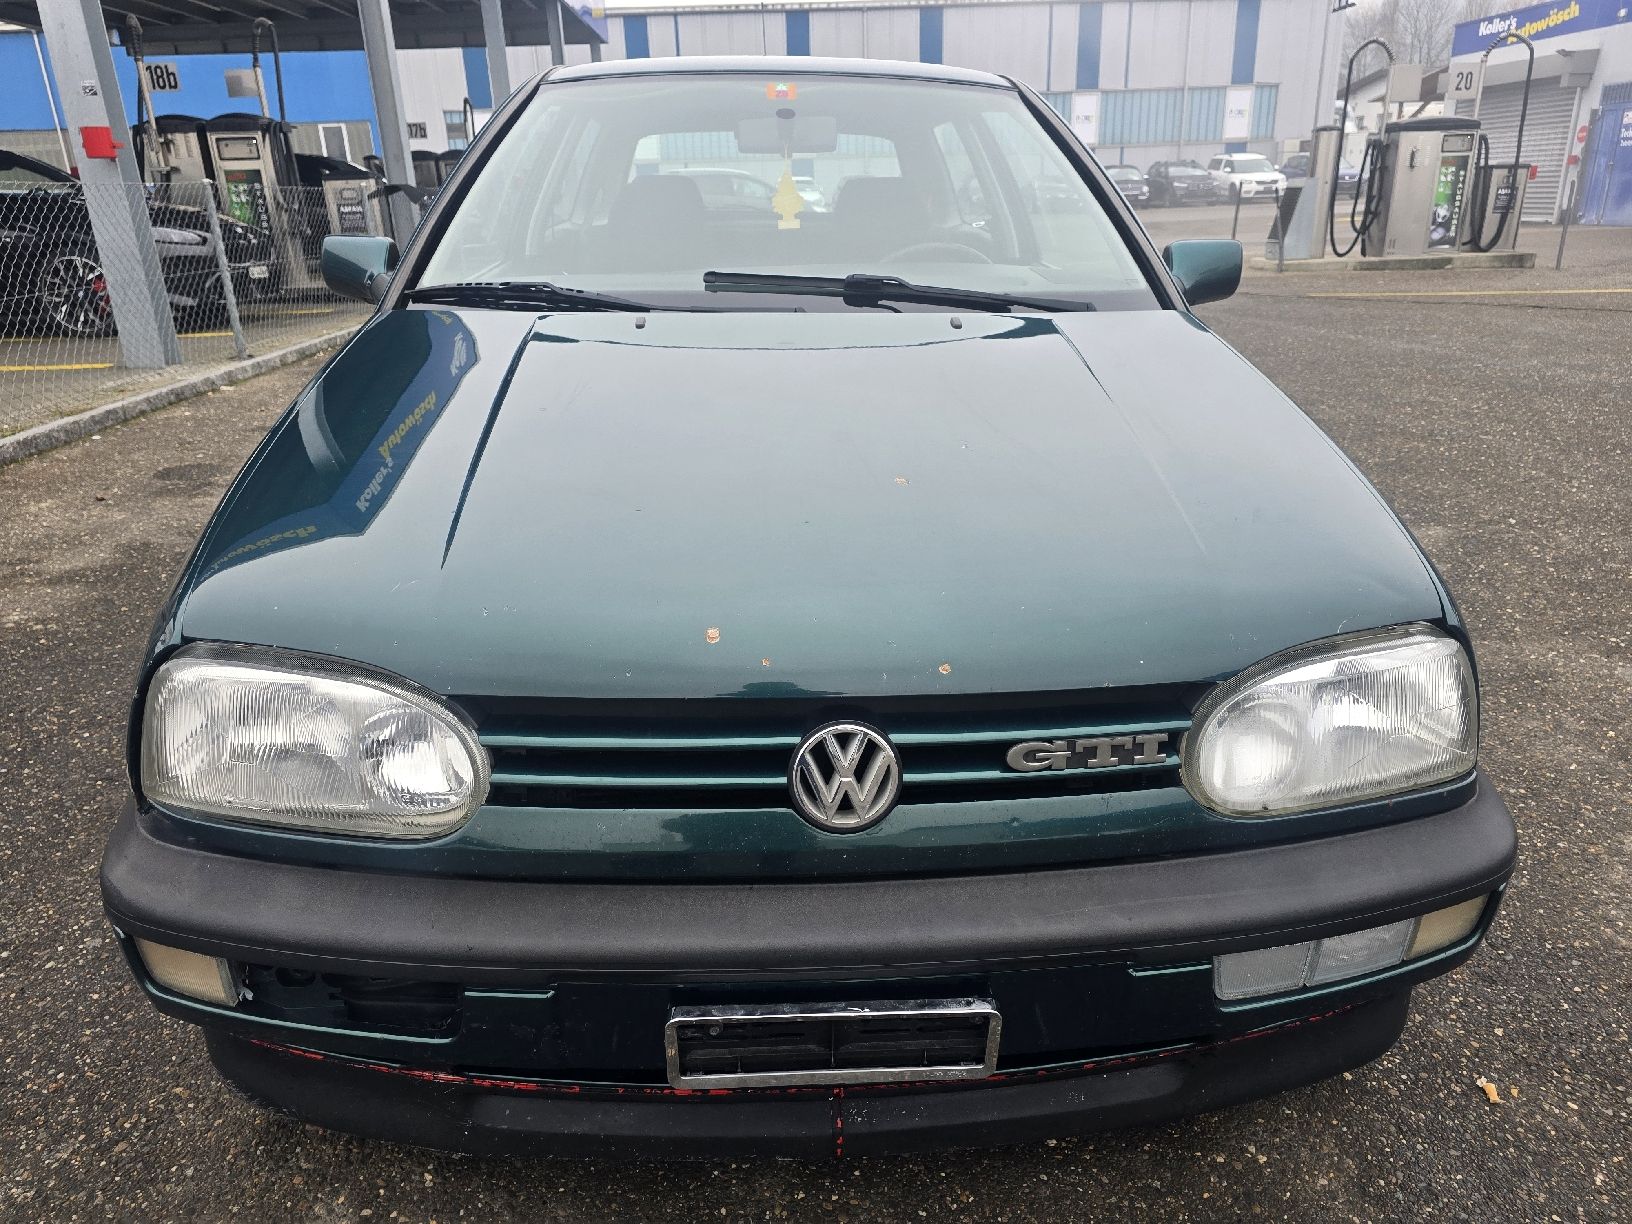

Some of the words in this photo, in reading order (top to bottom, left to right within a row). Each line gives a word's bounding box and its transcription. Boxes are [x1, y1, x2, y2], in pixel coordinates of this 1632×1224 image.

[145, 64, 178, 90] 18b
[1455, 71, 1473, 91] 20
[408, 123, 427, 138] 17b
[1006, 733, 1169, 772] GTI
